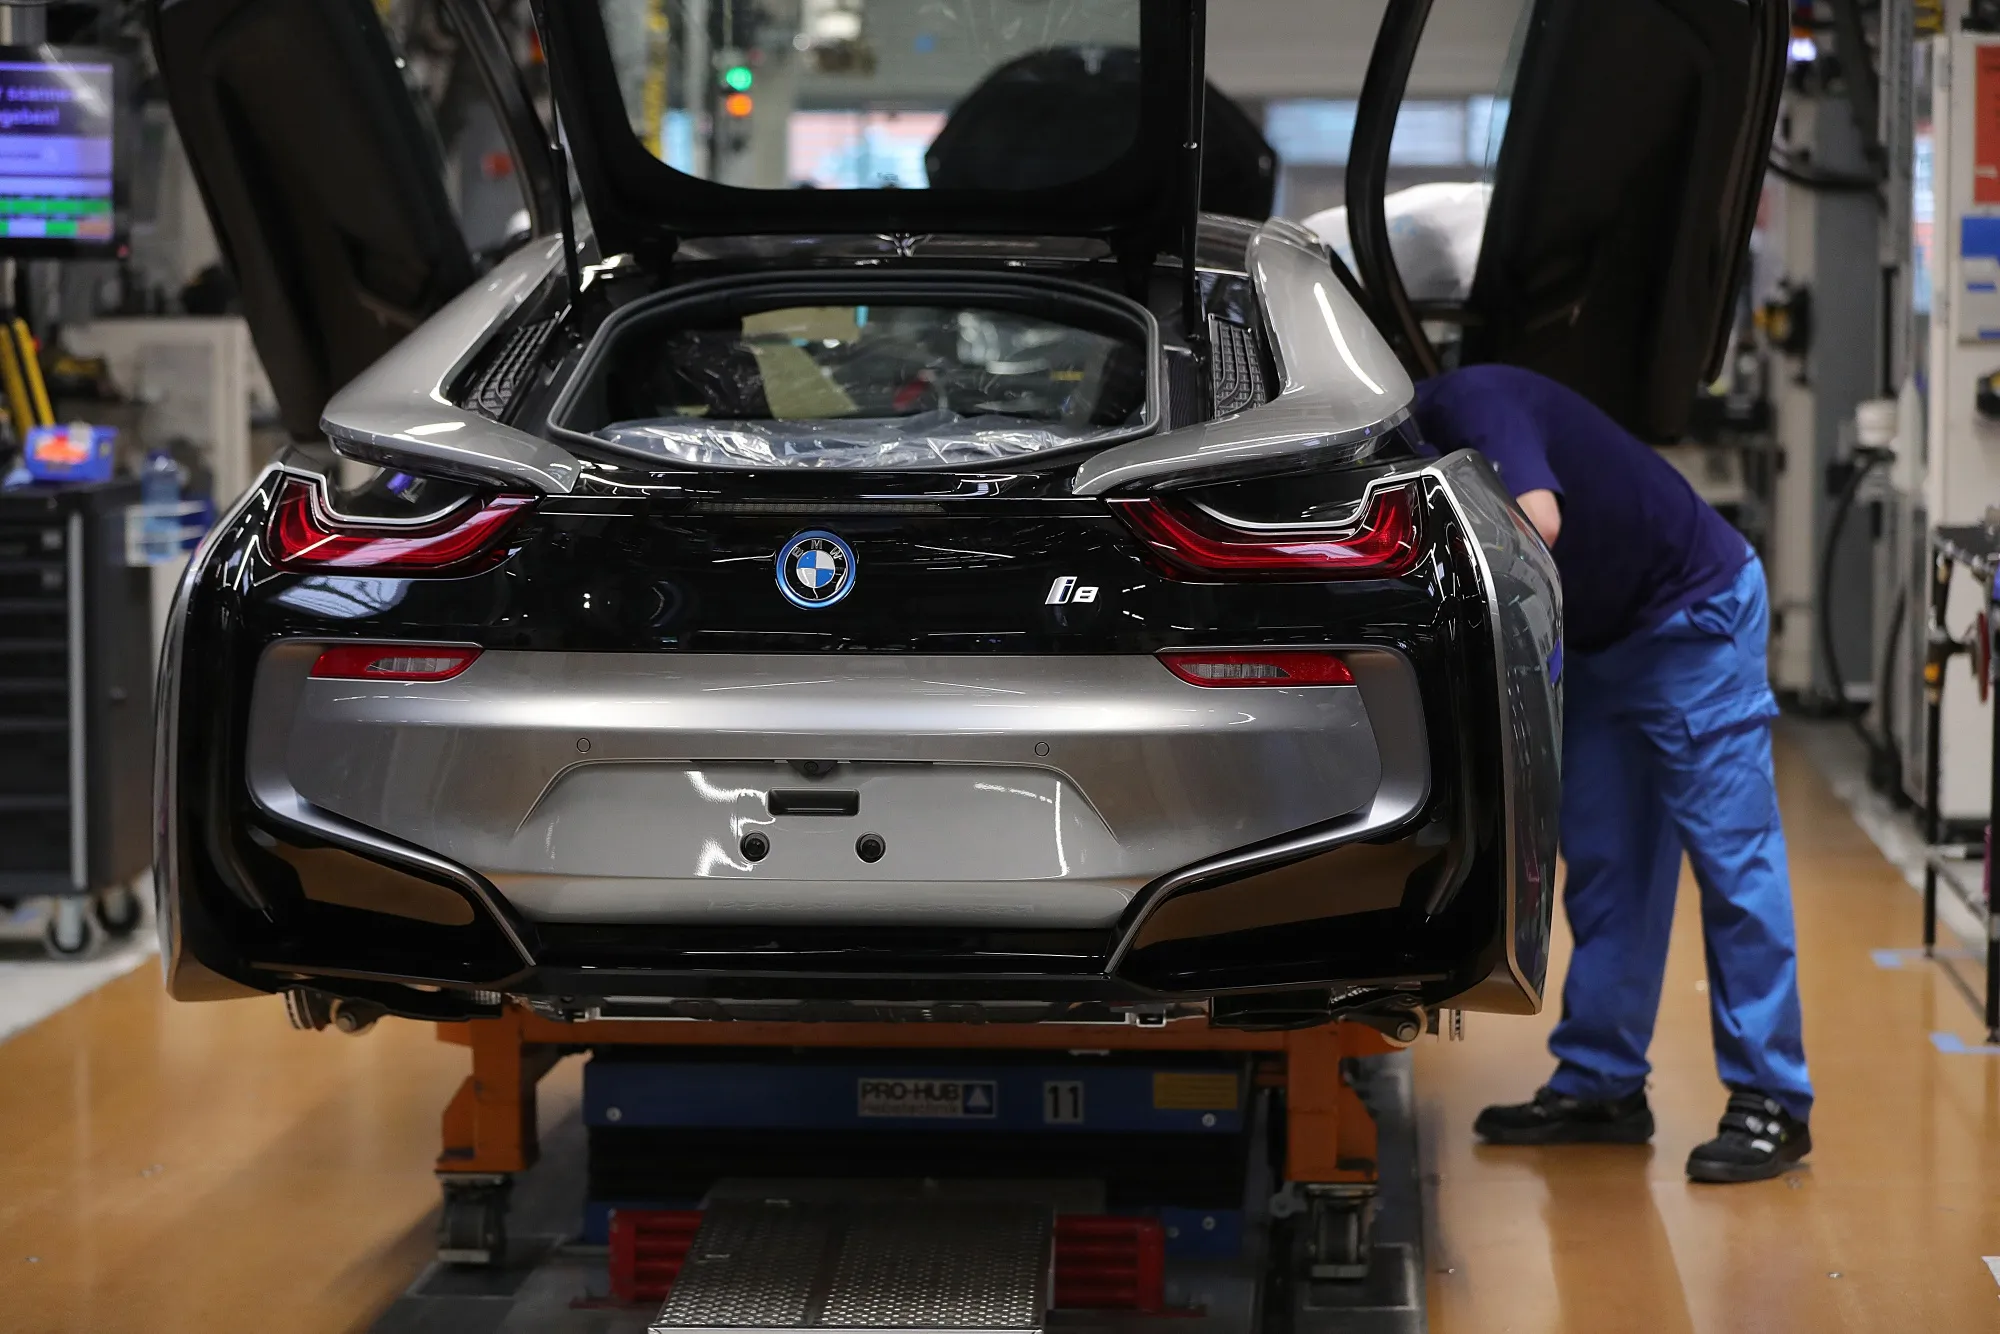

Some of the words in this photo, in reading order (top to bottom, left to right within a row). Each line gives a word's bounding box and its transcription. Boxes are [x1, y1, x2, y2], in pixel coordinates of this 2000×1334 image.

[791, 540, 843, 560] BMW
[1045, 576, 1099, 604] i8
[861, 1081, 960, 1101] PRO-HUB
[1048, 1085, 1079, 1119] 11
